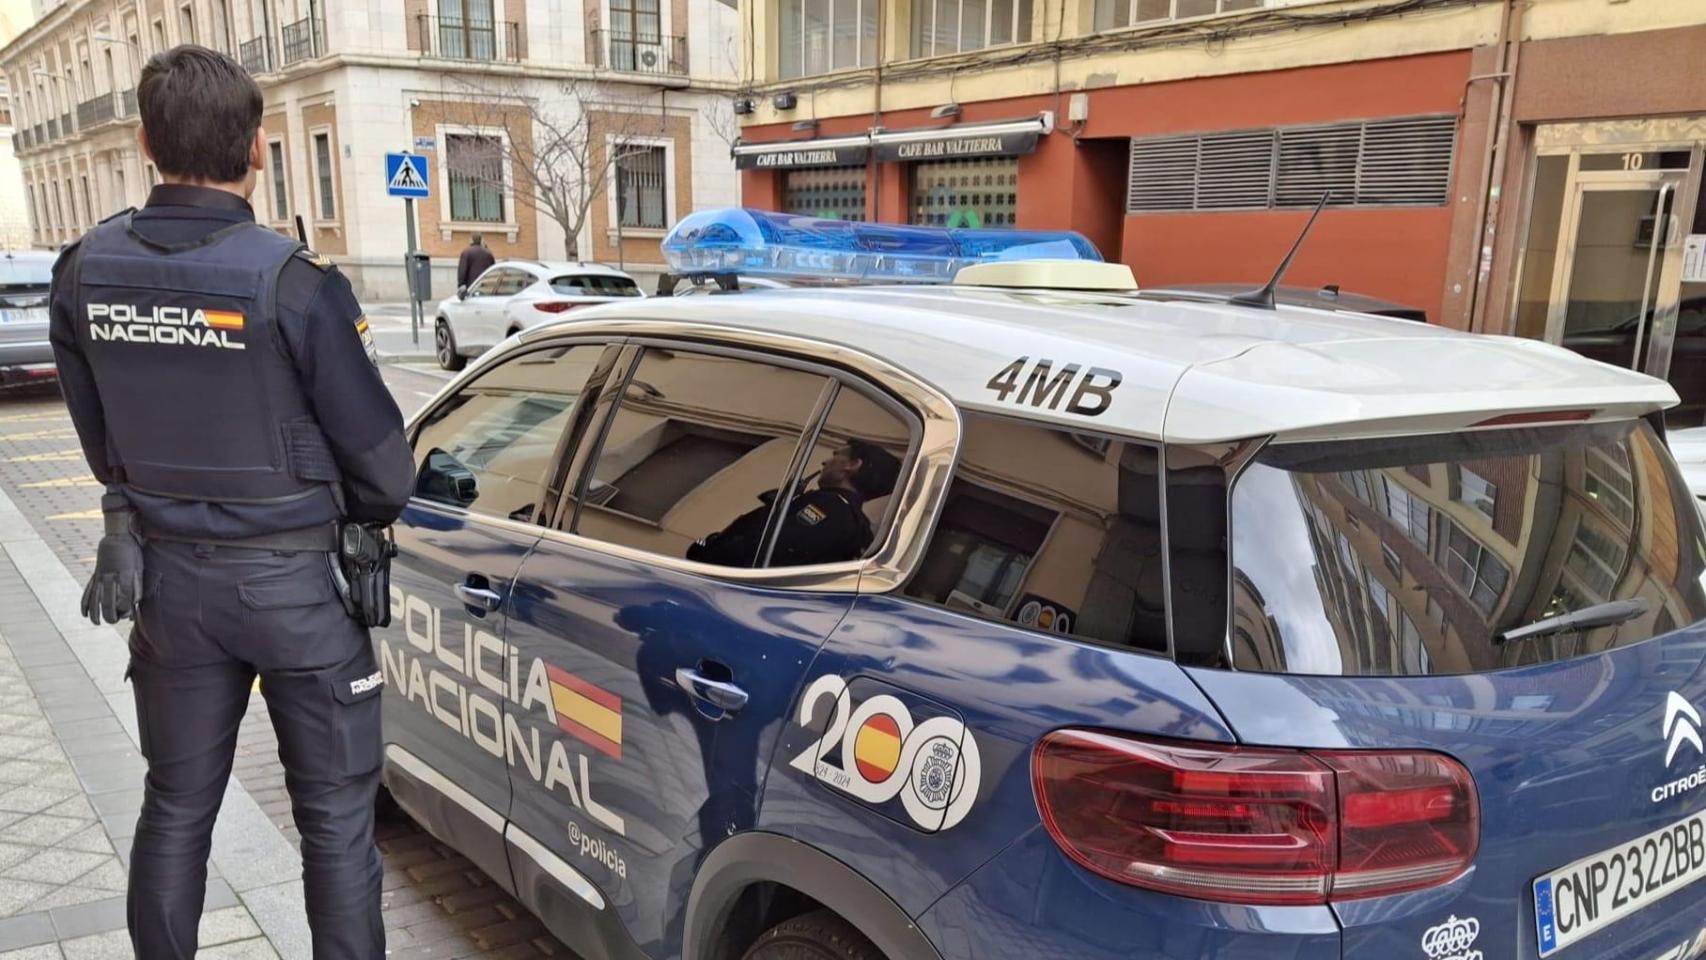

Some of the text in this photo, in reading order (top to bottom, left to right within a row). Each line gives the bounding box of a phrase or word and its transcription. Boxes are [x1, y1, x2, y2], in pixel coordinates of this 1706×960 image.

[757, 150, 837, 166] CAFE BAR VALTIERRA
[897, 138, 1002, 157] CAFE BAR VALTIERRA
[1621, 153, 1643, 170] 10
[87, 303, 210, 327] POLICIA
[90, 323, 246, 350] NACIONAL
[986, 355, 1123, 417] 4MB
[380, 639, 626, 836] NACIONAL
[789, 674, 982, 832] 200
[568, 821, 627, 879] @policia
[1555, 817, 1705, 934] CNP2322BB
[1542, 925, 1552, 942] E
